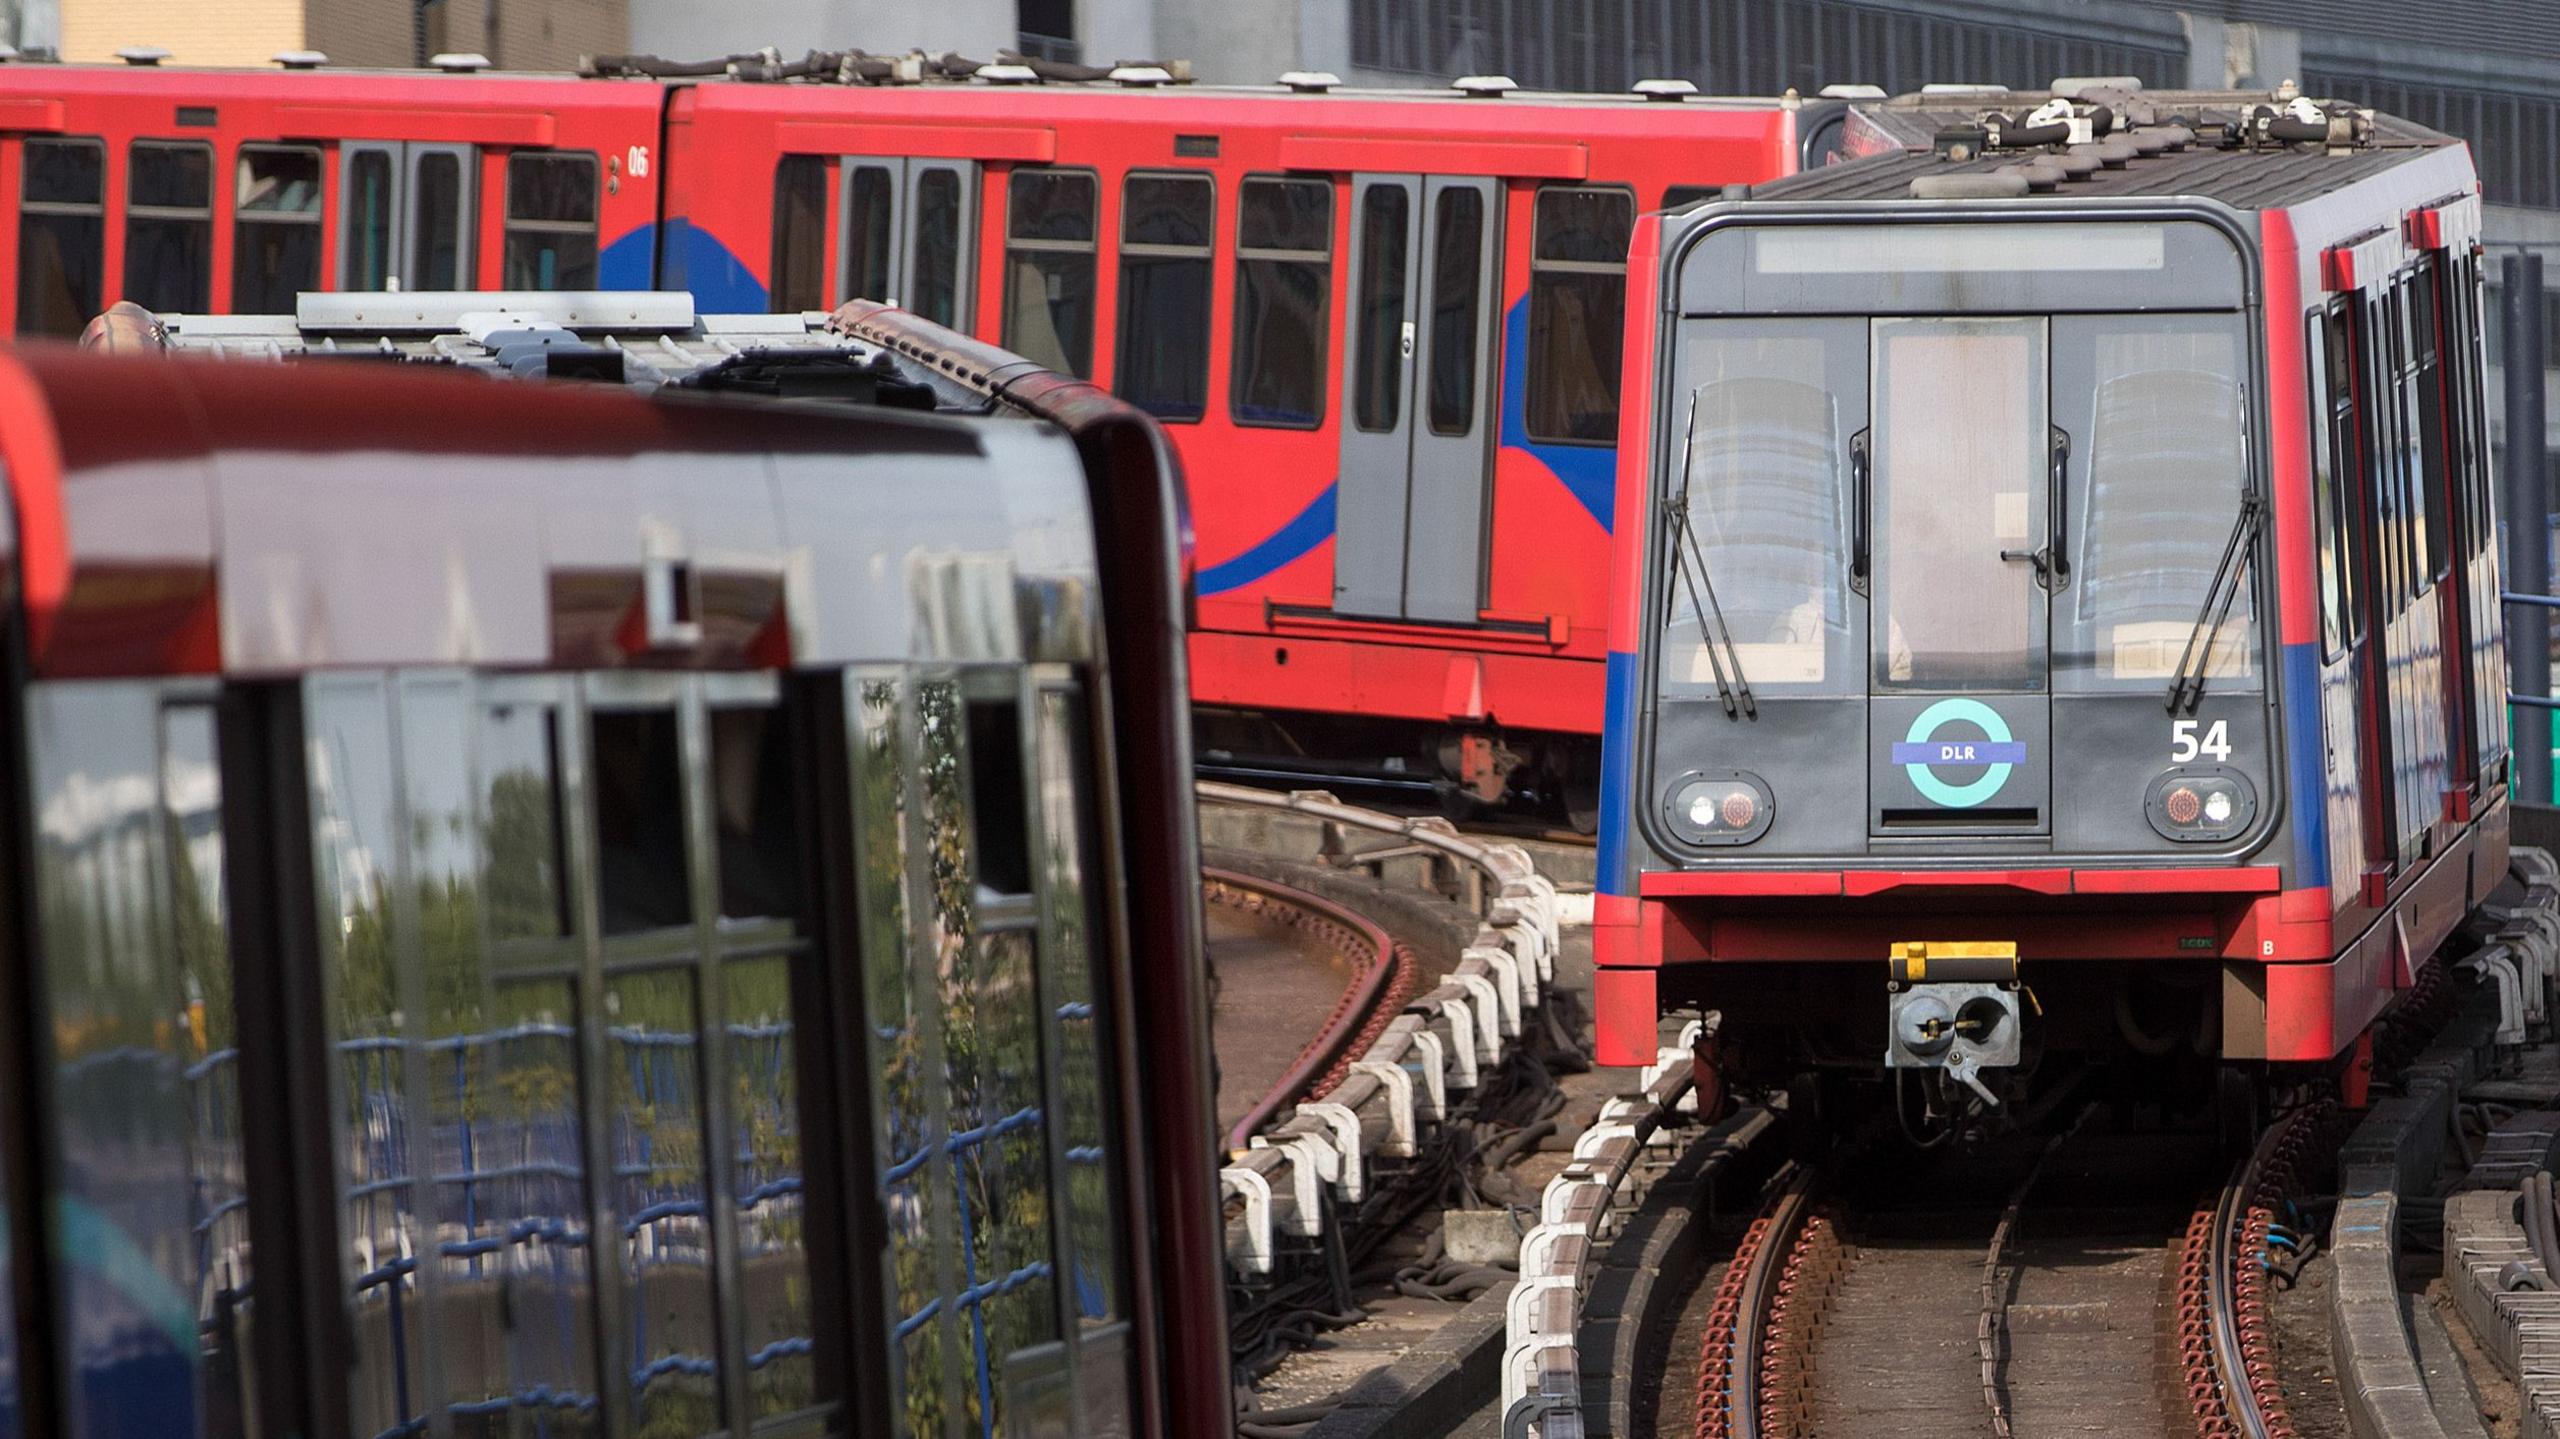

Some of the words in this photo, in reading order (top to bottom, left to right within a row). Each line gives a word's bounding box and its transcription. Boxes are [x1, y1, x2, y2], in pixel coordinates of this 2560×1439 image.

[628, 146, 649, 178] 06
[1941, 746, 1976, 761] DLR
[2171, 720, 2232, 763] 54
[2263, 940, 2274, 956] B
